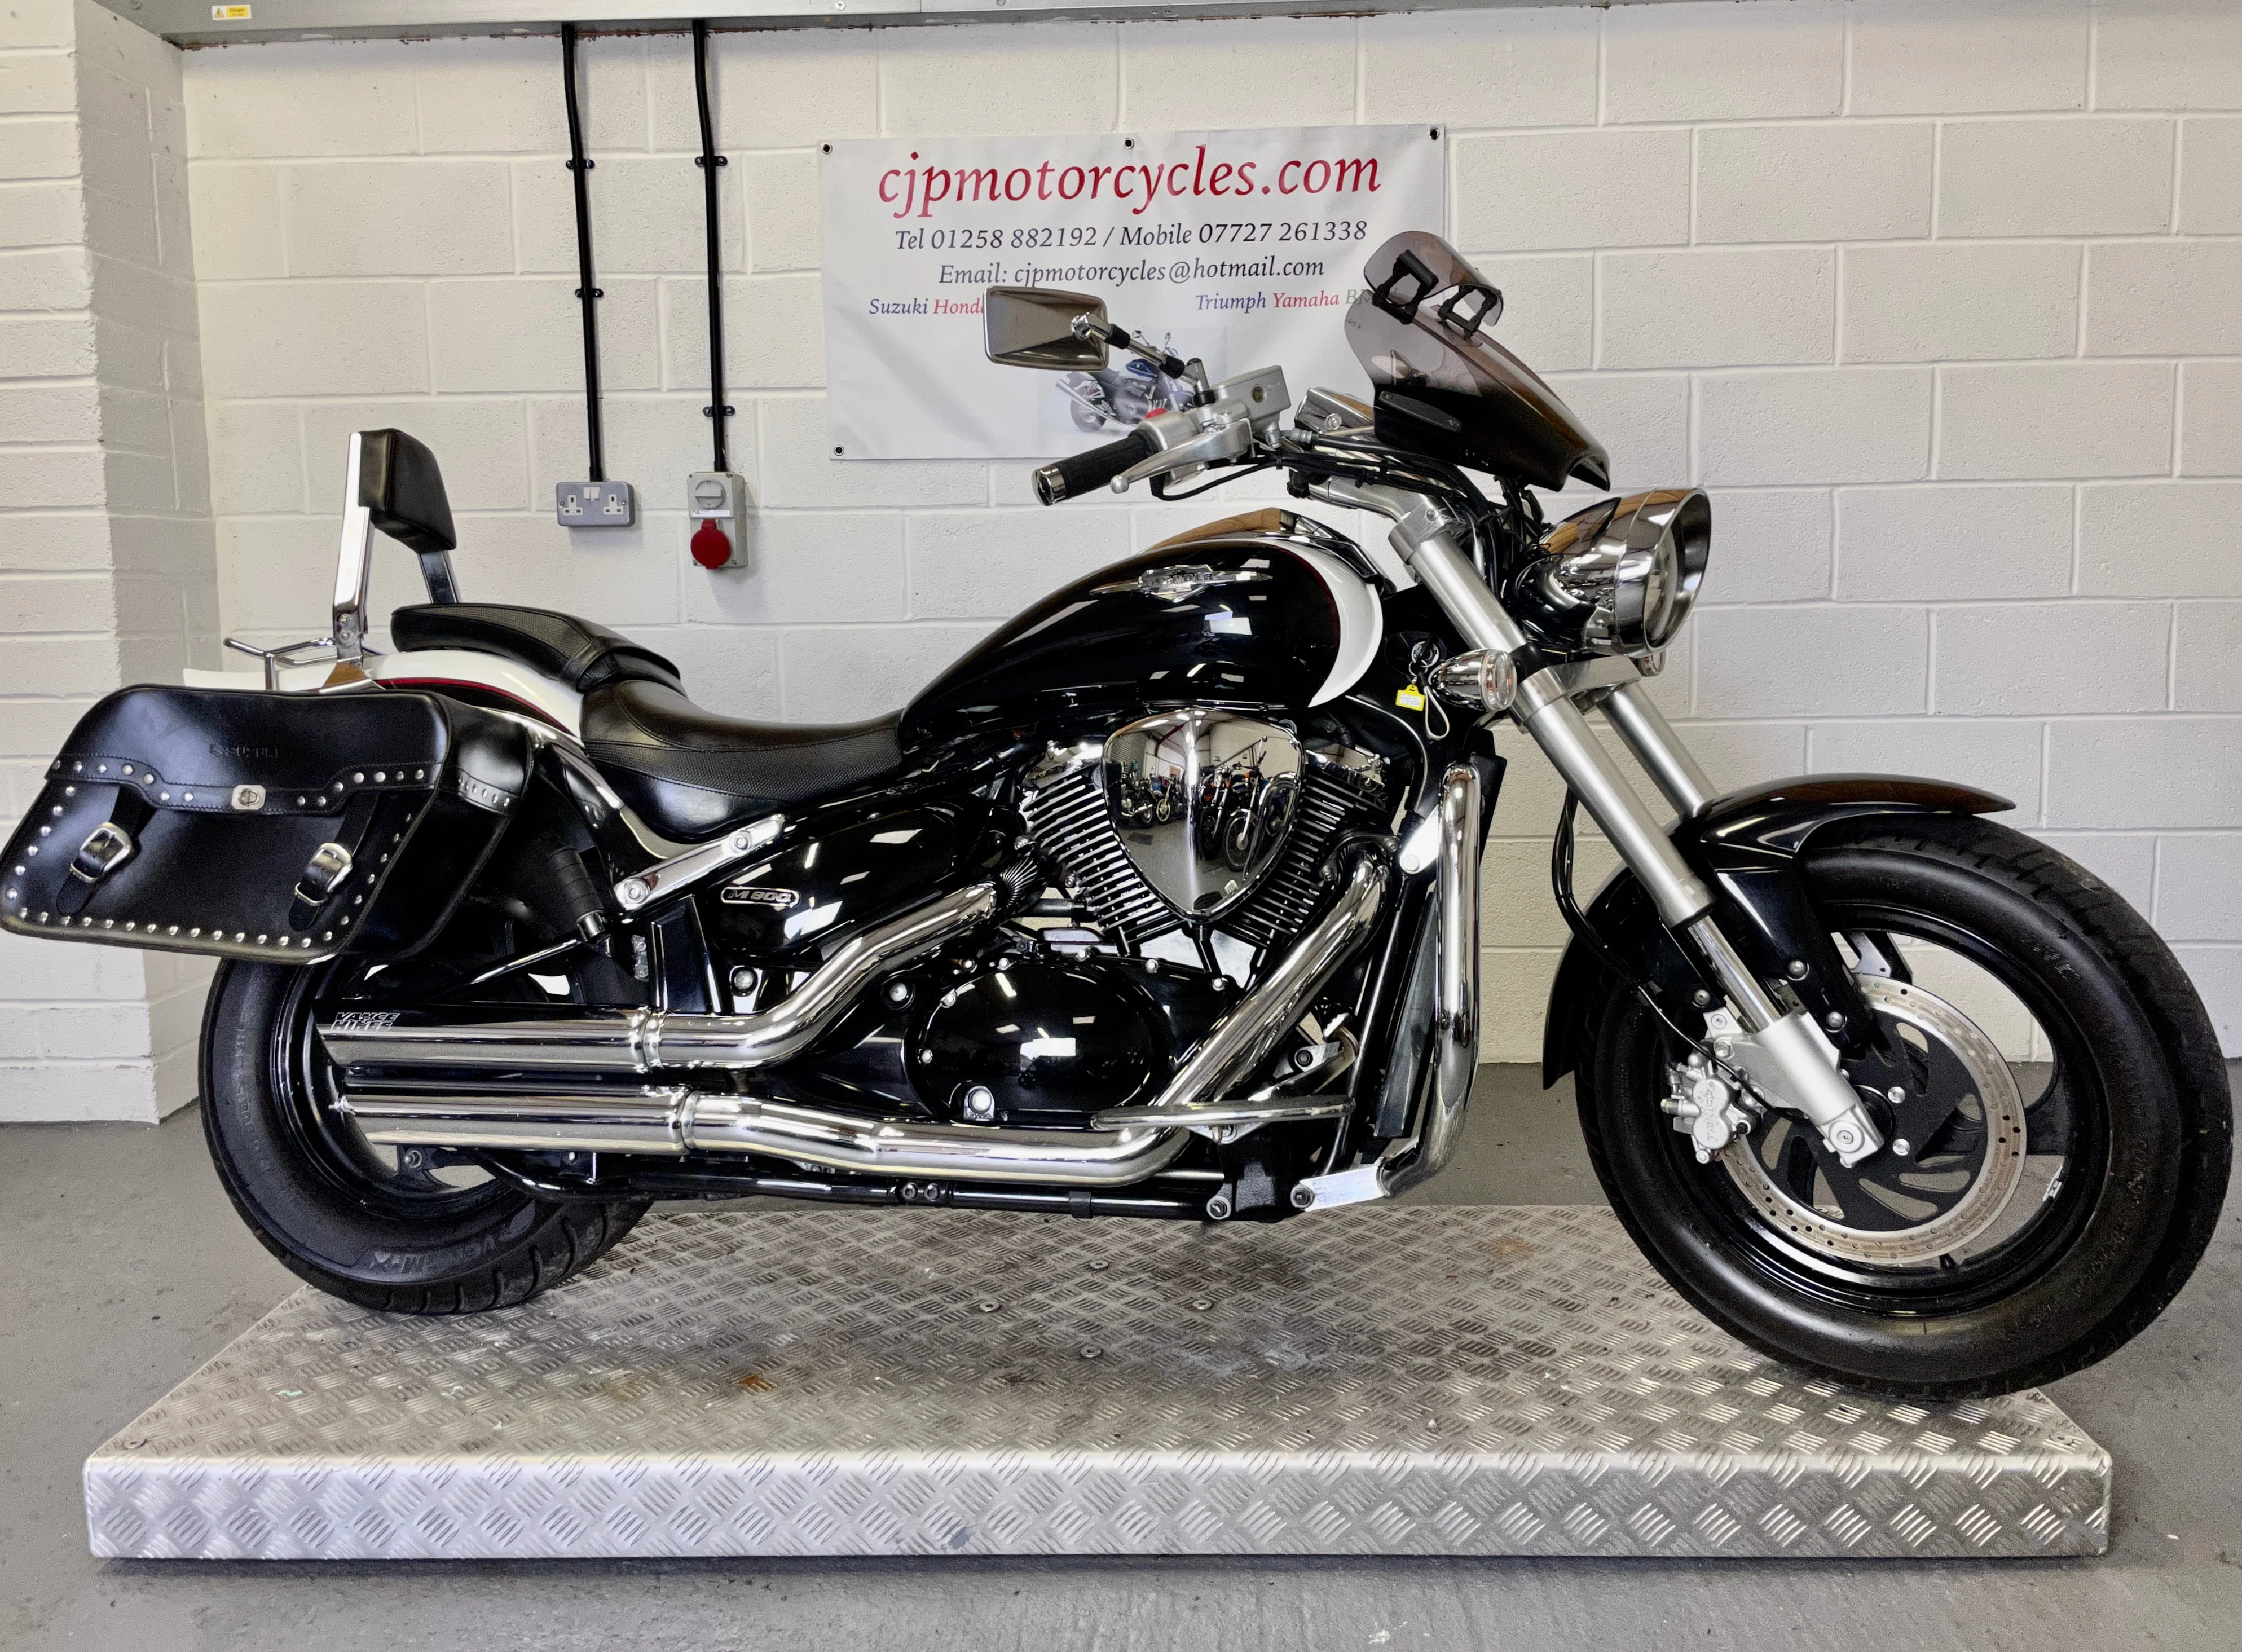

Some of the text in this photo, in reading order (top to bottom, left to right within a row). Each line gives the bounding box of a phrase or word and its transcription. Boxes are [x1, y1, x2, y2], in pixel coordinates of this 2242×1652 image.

[879, 144, 1381, 219] cjpmotorcycles.com
[895, 221, 1367, 249] Tel 01258 882192 / Mobile 07727 261338
[938, 255, 1324, 287] Email: cjpmotorcycles@hotmail.com
[869, 298, 928, 314] Suzuki
[1196, 291, 1267, 314] Triumph
[1272, 290, 1340, 308] Yamaha
[336, 1012, 400, 1021] VANCE
